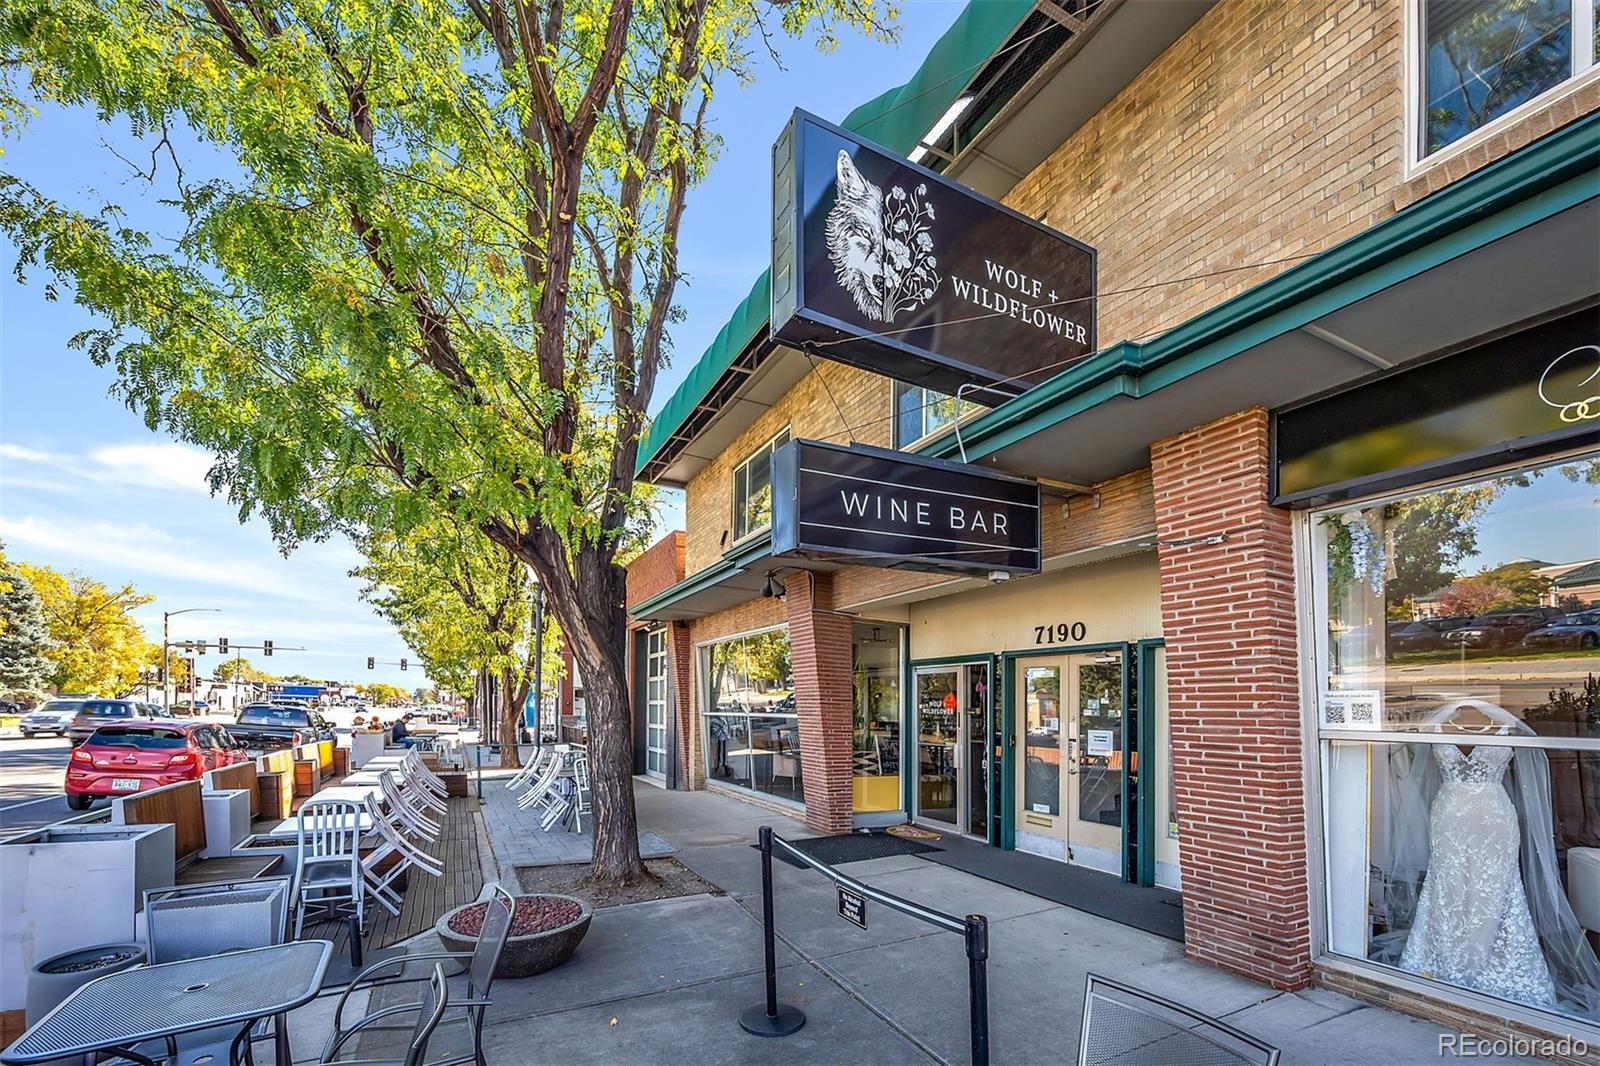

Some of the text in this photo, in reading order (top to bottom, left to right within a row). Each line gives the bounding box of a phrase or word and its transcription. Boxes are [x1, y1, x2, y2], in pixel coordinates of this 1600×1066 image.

[985, 259, 1059, 304] WOLF +
[951, 275, 1088, 345] WILDFLOWER
[840, 490, 1008, 536] WINE BAR
[1034, 622, 1086, 645] 7190
